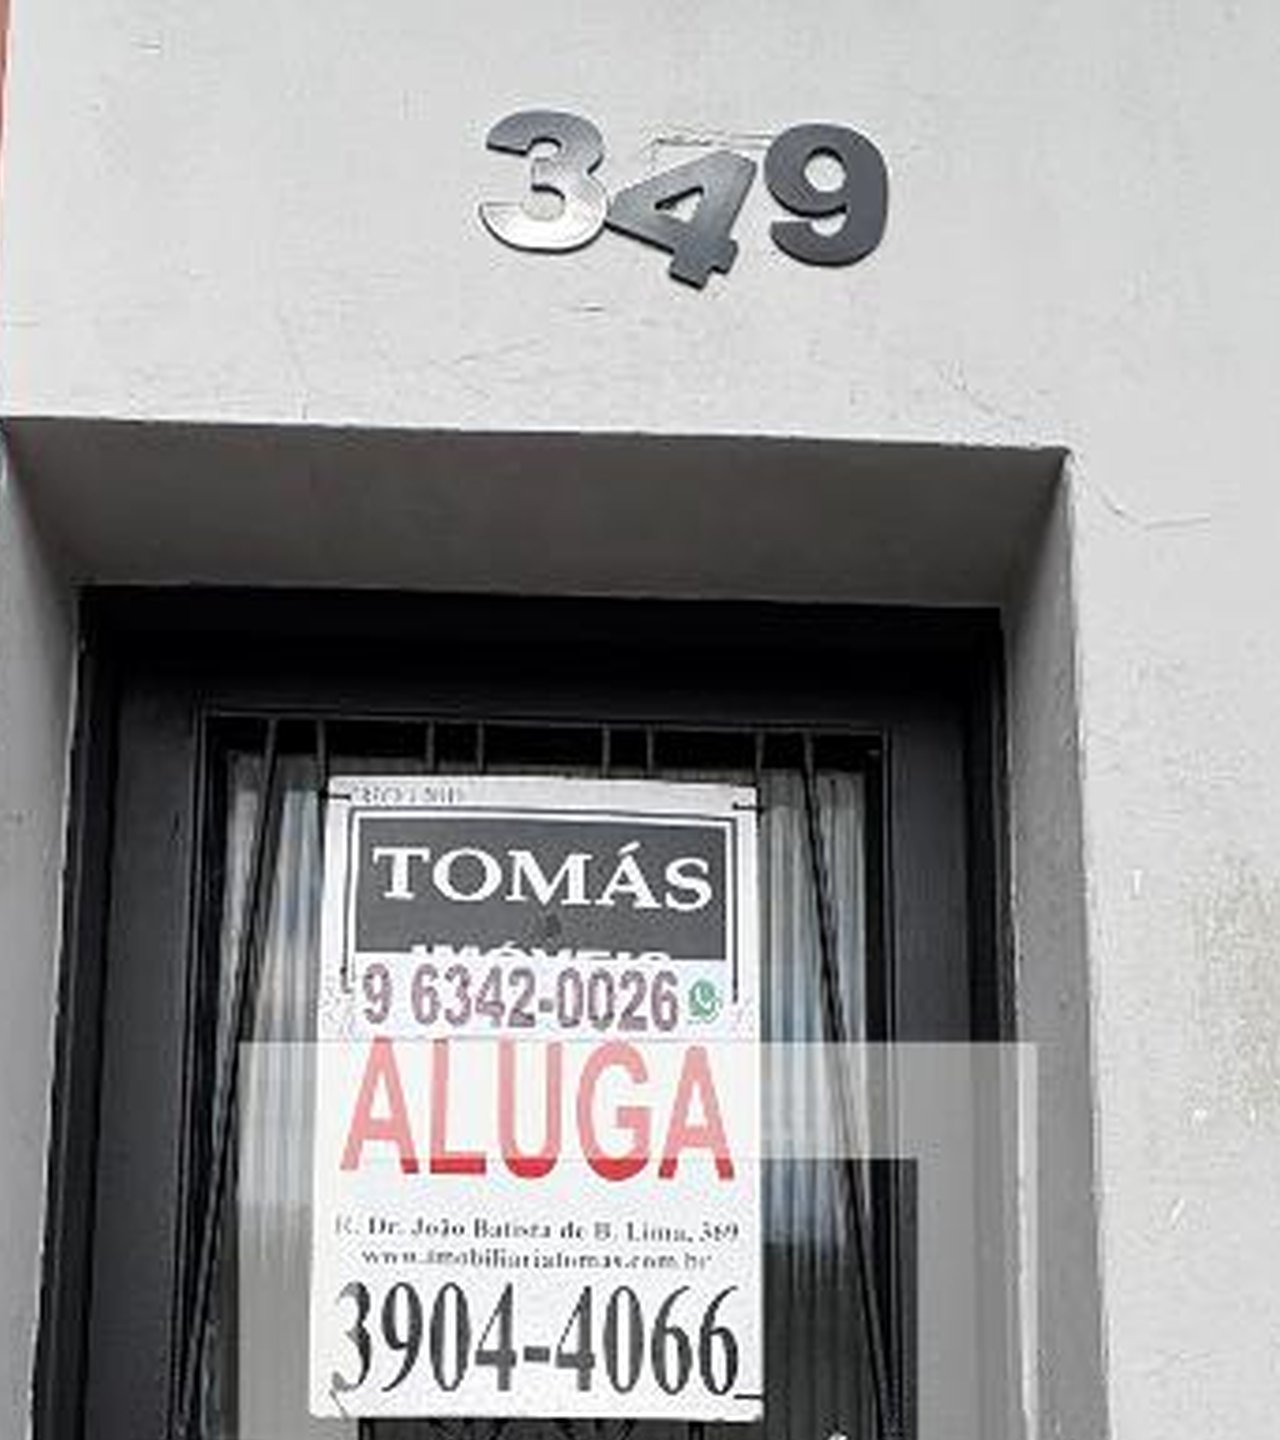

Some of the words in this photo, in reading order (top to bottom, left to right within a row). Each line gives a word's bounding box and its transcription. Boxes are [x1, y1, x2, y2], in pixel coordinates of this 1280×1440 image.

[478, 109, 889, 291] 349
[373, 841, 713, 911] TOMÁS
[362, 963, 392, 1024] 9
[411, 964, 679, 1031] 6342-0026
[340, 1036, 735, 1181] ALUGA
[368, 1217, 405, 1235] Dr.
[411, 1217, 465, 1236] João
[560, 1221, 584, 1240] de
[332, 1281, 738, 1395] 3904-4066
